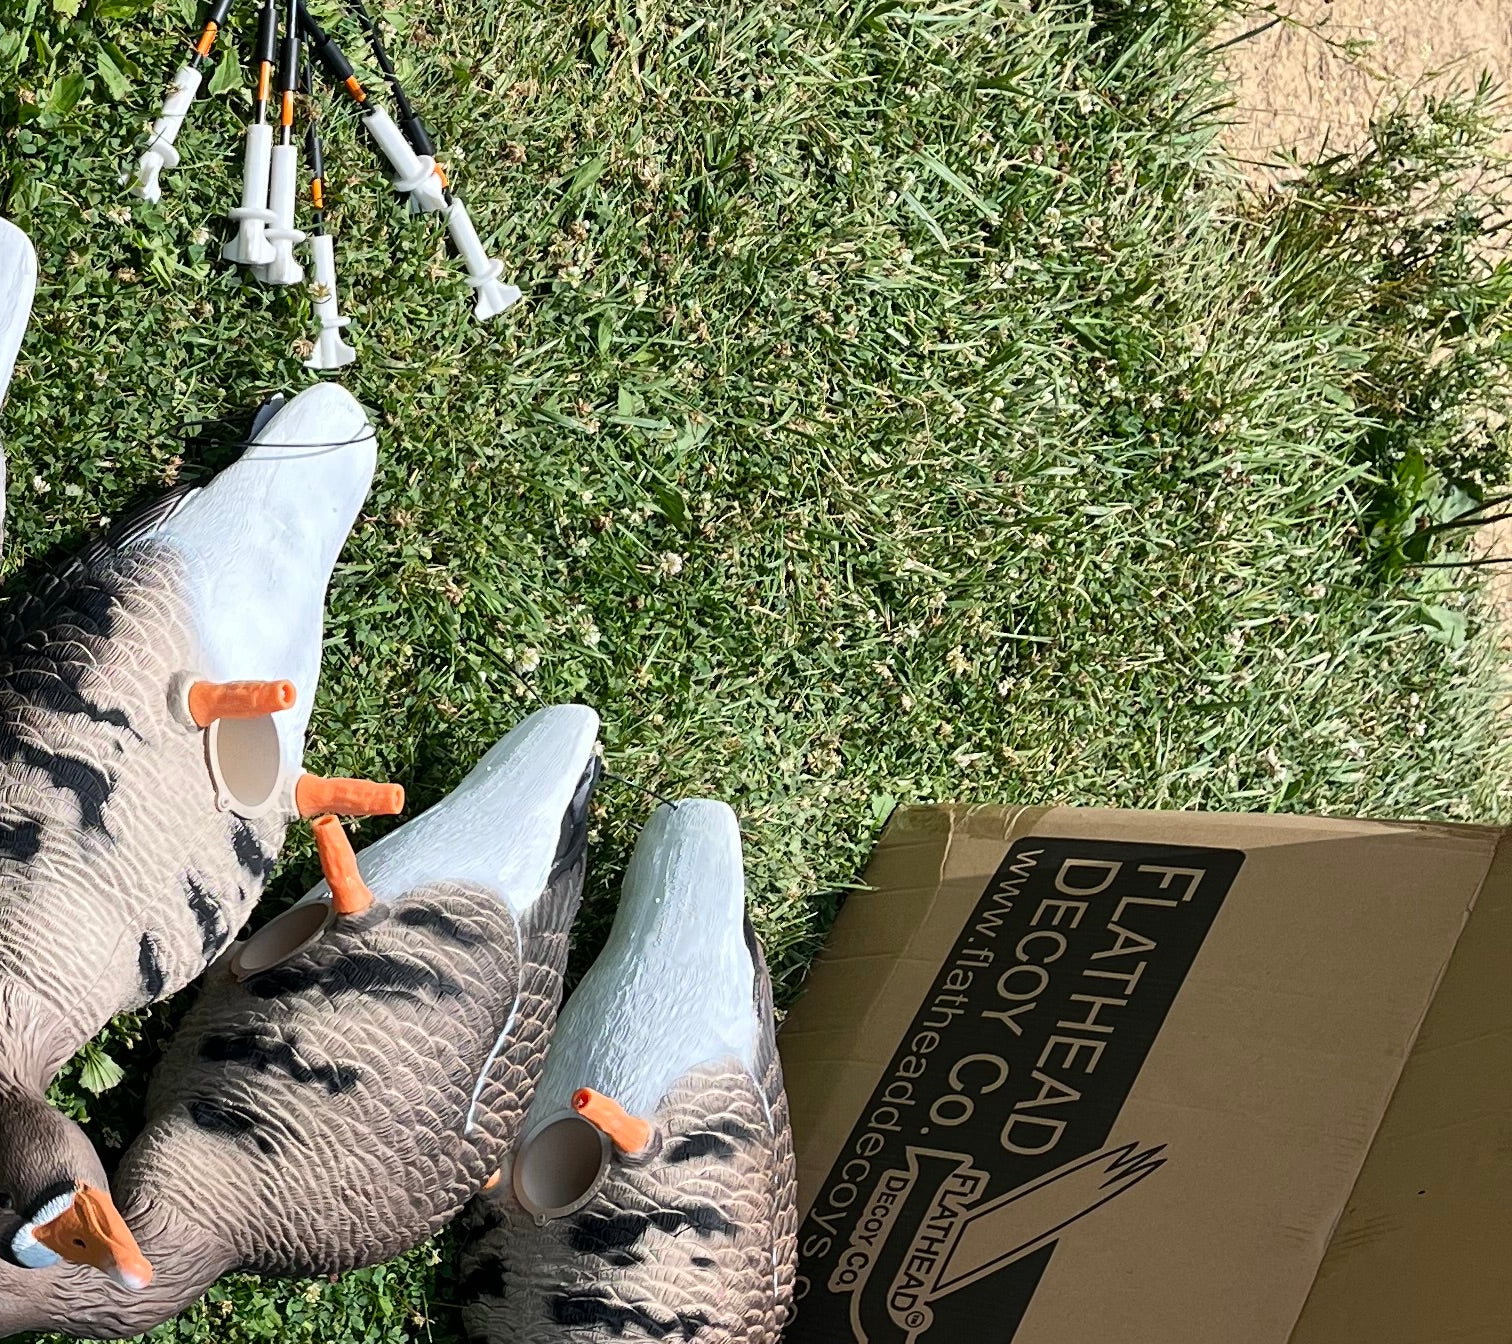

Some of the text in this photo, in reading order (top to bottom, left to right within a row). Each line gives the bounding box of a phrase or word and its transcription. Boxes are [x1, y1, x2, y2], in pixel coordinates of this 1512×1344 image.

[980, 857, 1123, 1036] DECOY
[1000, 863, 1207, 1155] FLATHEAD
[858, 1175, 909, 1247] DECOY
[890, 1173, 981, 1311] FLATHEAD
